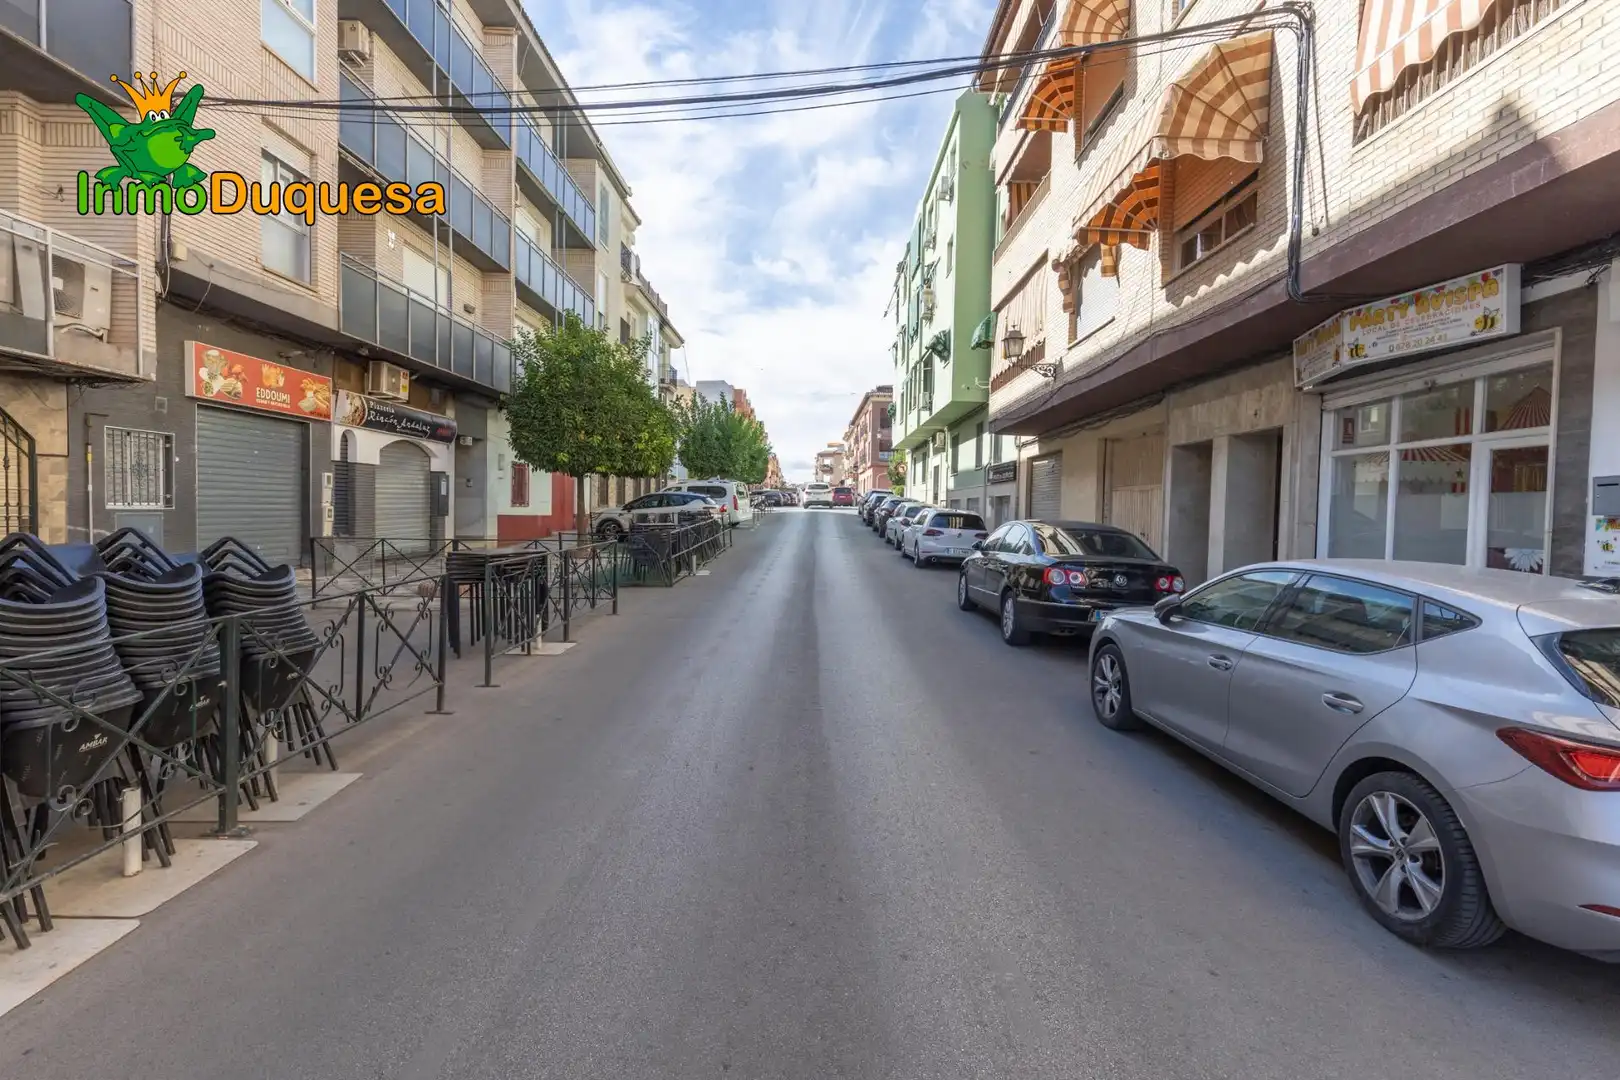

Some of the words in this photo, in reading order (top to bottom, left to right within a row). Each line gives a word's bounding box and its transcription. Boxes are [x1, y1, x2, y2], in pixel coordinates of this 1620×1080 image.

[1350, 302, 1409, 331] PARTY
[1415, 278, 1499, 315] AVISPA
[1362, 324, 1387, 336] LOCAL
[256, 387, 290, 403] EDDOUMI
[368, 410, 398, 426] Rincón
[79, 736, 108, 752] AMBAR
